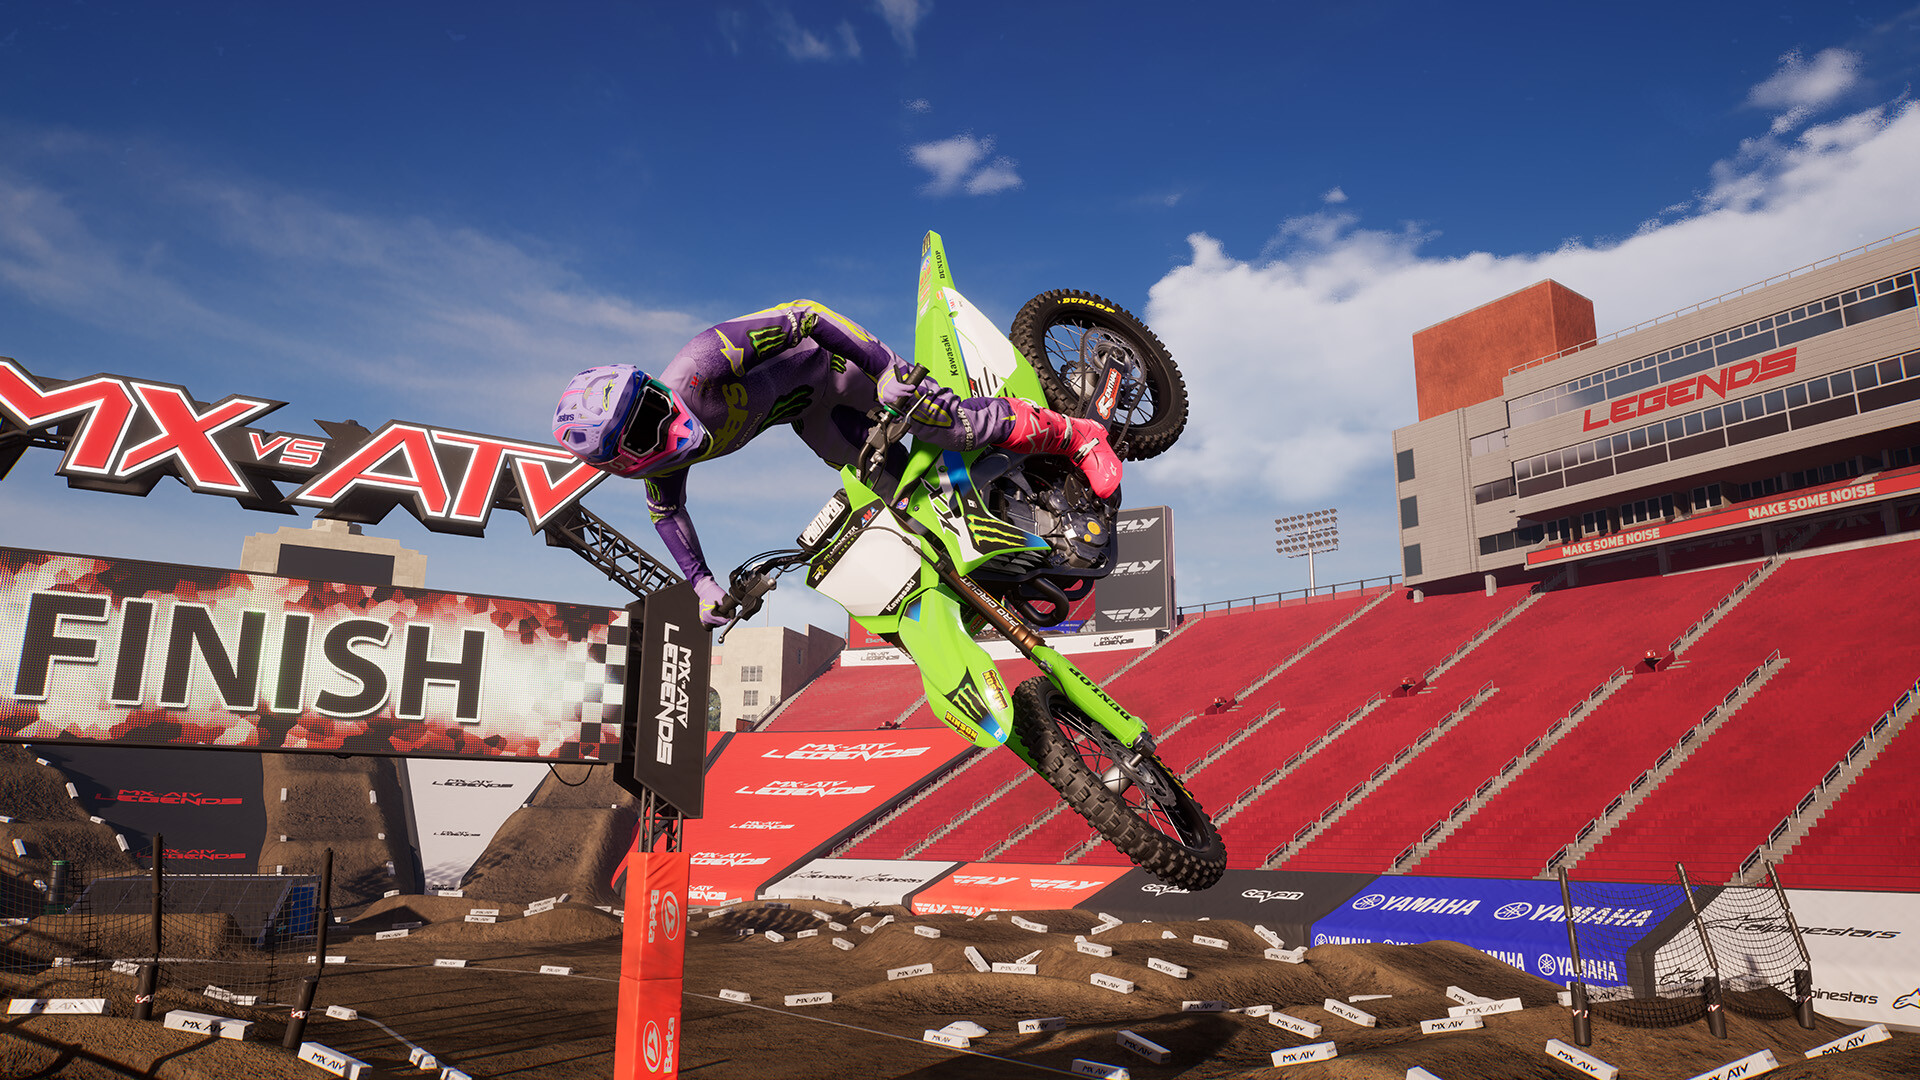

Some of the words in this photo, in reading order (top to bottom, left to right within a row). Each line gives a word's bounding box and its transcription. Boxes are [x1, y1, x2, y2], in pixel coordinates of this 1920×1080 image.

[935, 250, 946, 279] DUNLOP
[1062, 297, 1116, 313] DUNLOP
[940, 334, 959, 376] Kawasaki
[1582, 347, 1798, 432] LEGENDS
[0, 359, 271, 494] MX
[295, 421, 606, 527] ATV
[1748, 501, 1787, 519] MAKE
[1788, 493, 1829, 511] SOME
[1831, 483, 1876, 503] NOISE
[1116, 517, 1160, 531] FLY
[1562, 542, 1593, 557] MAKE
[1594, 534, 1625, 550] SOME
[1626, 528, 1660, 544] NOISE
[1110, 559, 1162, 574] FLY
[885, 579, 917, 612] Kawasaki
[959, 577, 998, 609] CIRCUIT
[996, 608, 1020, 627] PRO
[1101, 606, 1163, 620] FLY
[14, 591, 488, 723] FINISH
[655, 622, 680, 766] LEGENDS
[1068, 666, 1132, 721] DUNLOP
[761, 747, 931, 762] LEGENDS
[95, 793, 243, 806] LEGENDS
[734, 785, 876, 797] LEGENDS
[1380, 896, 1481, 915] YAMAHA
[648, 889, 660, 943] Beta
[1529, 904, 1653, 927] YAMAHA
[182, 1019, 202, 1031] MX
[1431, 1022, 1446, 1031] MX
[663, 1016, 675, 1074] Beta
[1845, 1034, 1866, 1051] ATV
[311, 1052, 329, 1066] MX
[1282, 1052, 1297, 1063] MX
[1556, 1050, 1576, 1063] MX
[1726, 1062, 1750, 1080] ATV
